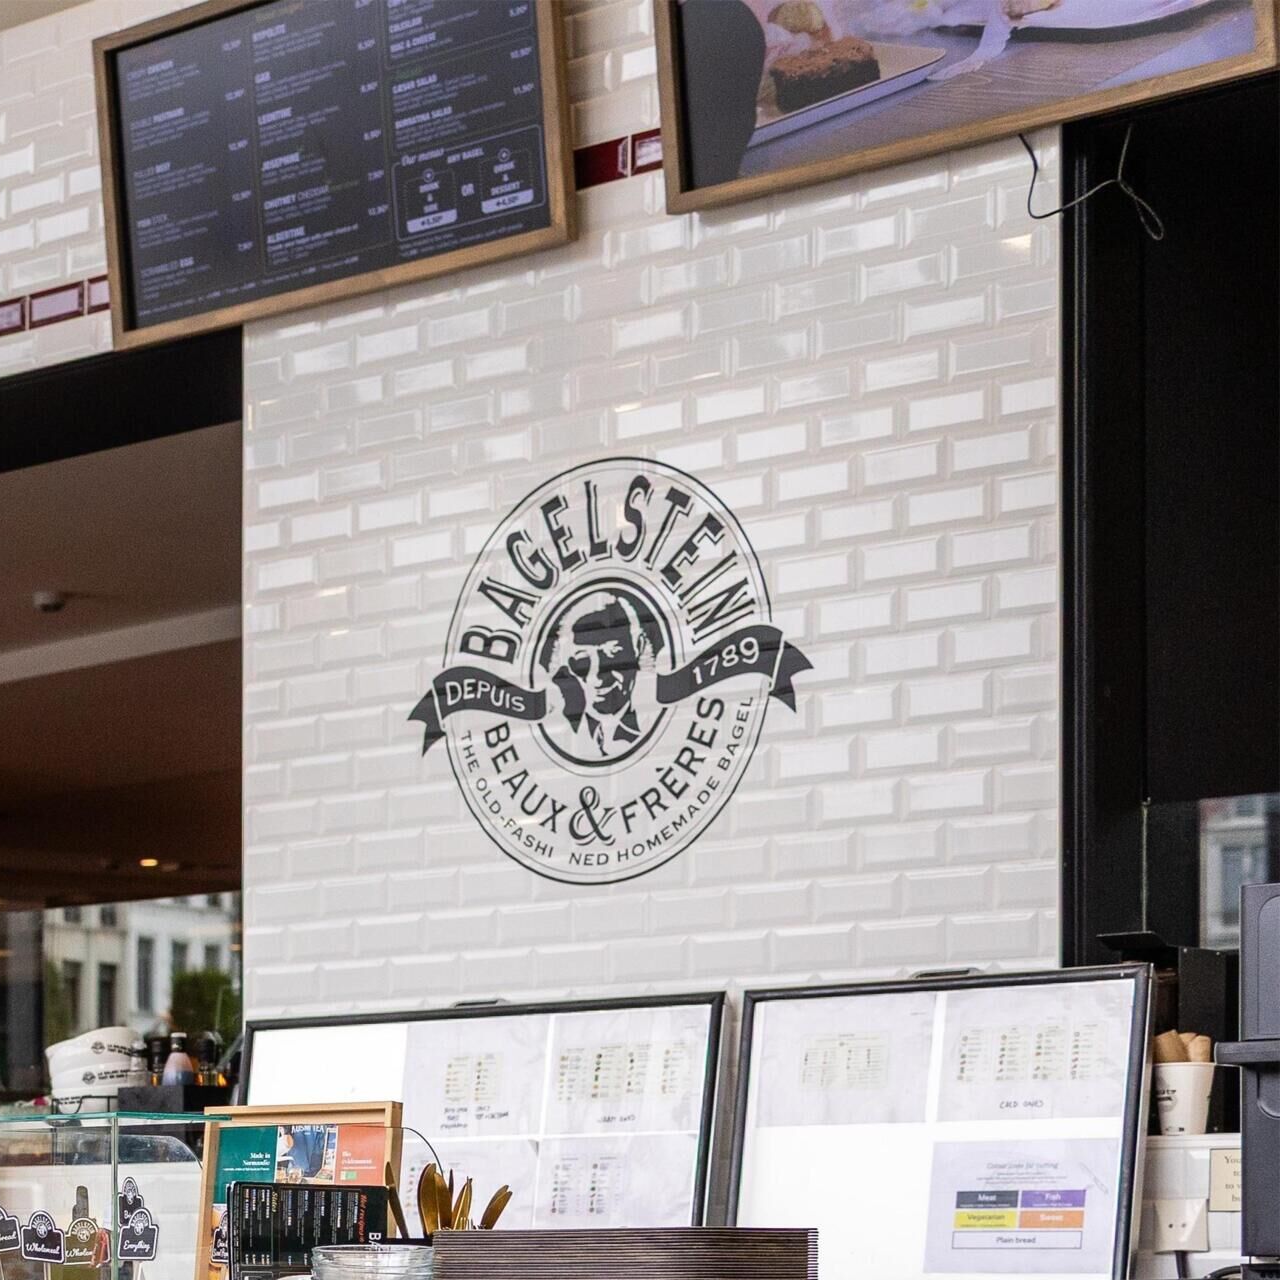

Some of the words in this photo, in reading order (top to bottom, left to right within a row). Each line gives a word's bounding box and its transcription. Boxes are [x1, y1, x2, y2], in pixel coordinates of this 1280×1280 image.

[461, 183, 475, 197] OR
[460, 475, 757, 664] BAGELSTEIN
[692, 636, 760, 684] 1789
[445, 680, 527, 713] DEPUIS
[484, 721, 568, 833] BEAUX
[568, 785, 622, 847] &
[619, 696, 726, 833] FRÈRES
[459, 730, 481, 774] THE
[616, 775, 721, 863] HOMEMADE
[717, 697, 754, 771] BAGEL
[271, 1191, 279, 1213] Sides
[360, 1193, 368, 1206] Hot
[977, 1193, 997, 1202] Meat
[1045, 1192, 1061, 1201] Fish
[358, 1208, 367, 1236] recipes
[967, 1213, 1006, 1222] Vegetarian
[123, 1240, 150, 1252] Everything
[996, 1236, 1014, 1244] Plain
[1015, 1236, 1037, 1244] bread
[26, 1243, 60, 1254] Wholemeal
